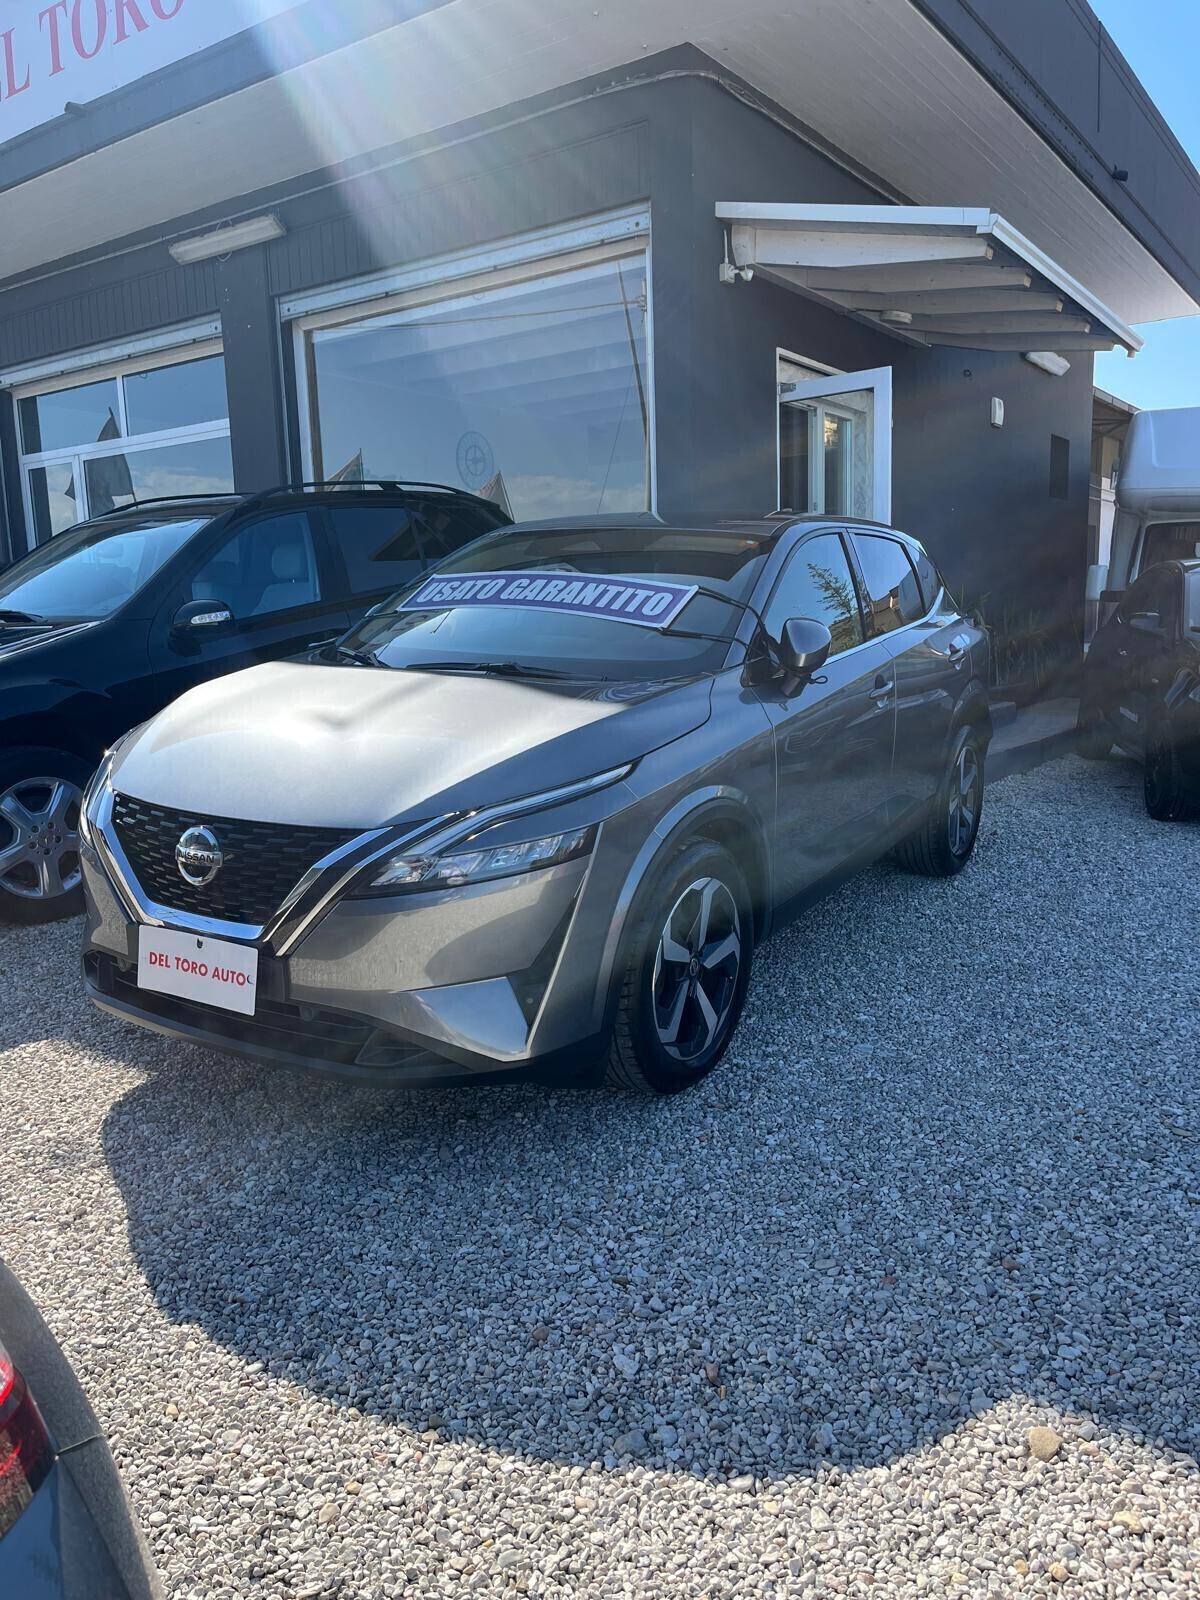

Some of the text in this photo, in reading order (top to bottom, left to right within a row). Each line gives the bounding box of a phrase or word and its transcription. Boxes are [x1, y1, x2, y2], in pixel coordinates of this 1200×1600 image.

[0, 0, 184, 101] L TOR
[416, 578, 674, 616] USATO GARANTITO
[178, 848, 215, 863] NISSAN
[149, 952, 247, 987] DEL TORO AUTO
